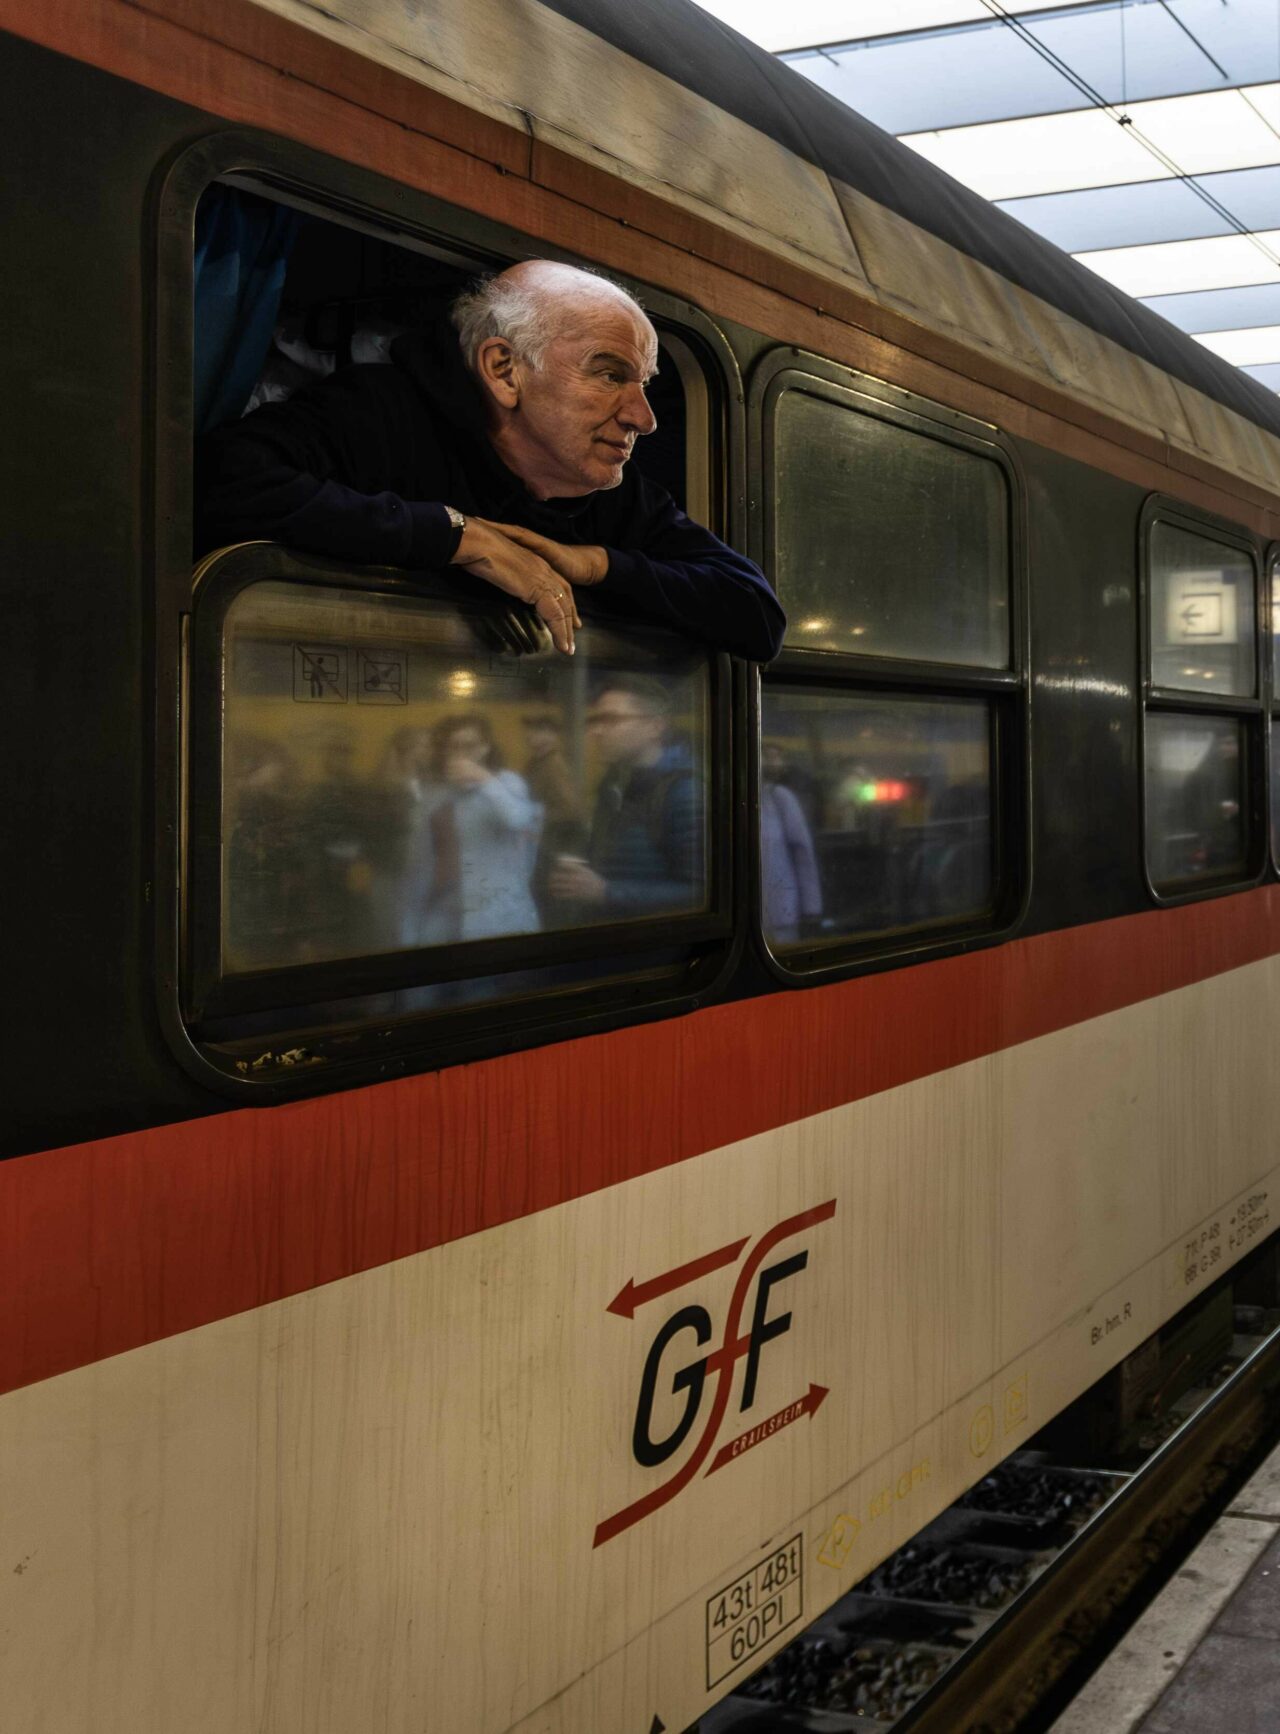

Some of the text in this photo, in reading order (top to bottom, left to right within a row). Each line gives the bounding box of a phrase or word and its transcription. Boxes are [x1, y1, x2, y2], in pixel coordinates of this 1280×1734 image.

[731, 1401, 803, 1456] CRAILSHEIM
[712, 1548, 798, 1630] 43t 48t
